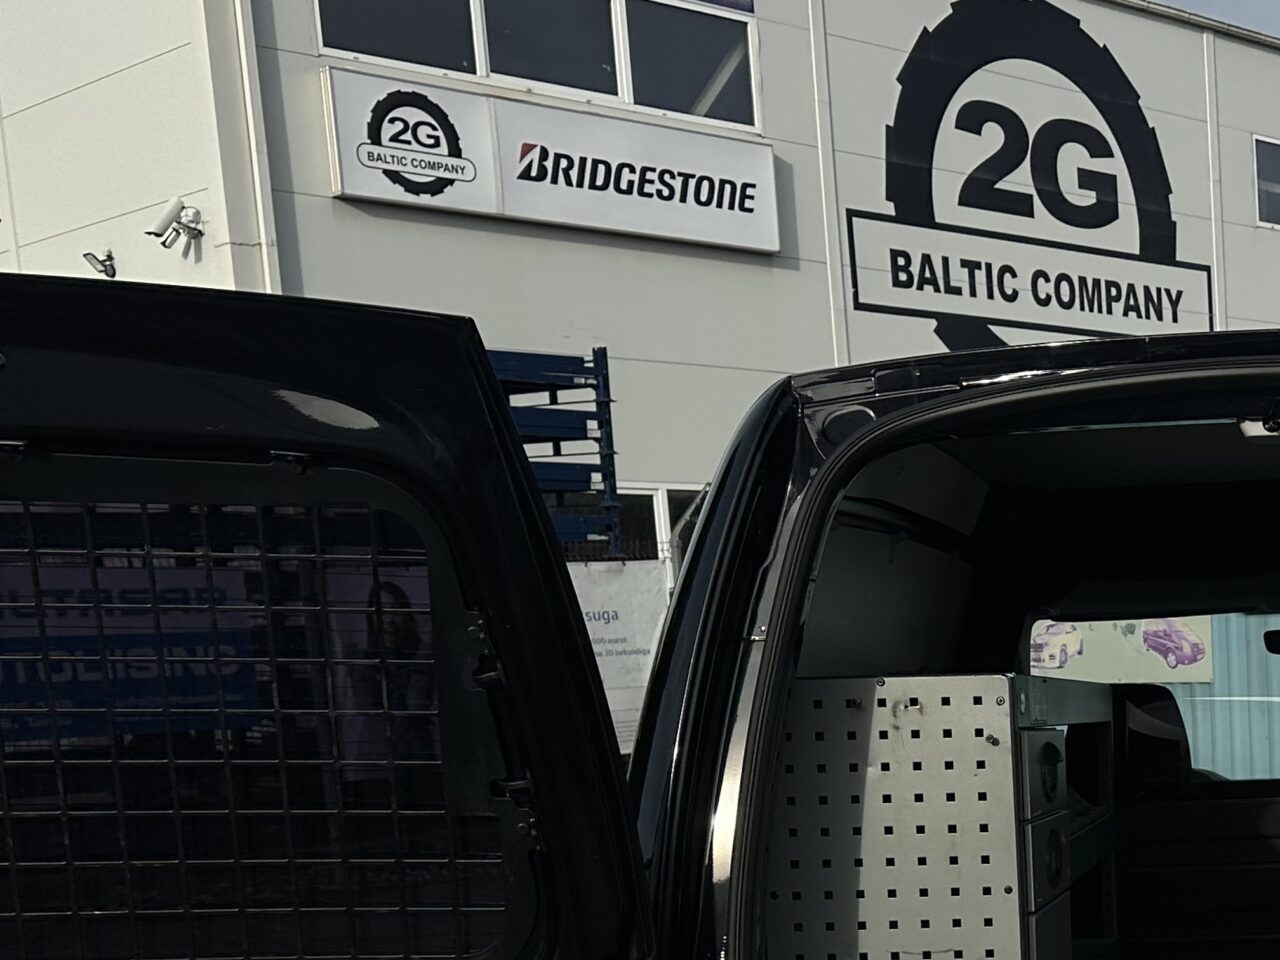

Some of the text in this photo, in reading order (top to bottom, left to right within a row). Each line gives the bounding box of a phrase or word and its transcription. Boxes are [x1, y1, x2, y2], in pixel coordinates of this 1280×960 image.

[367, 150, 466, 175] BALTIC COMPANY
[386, 116, 441, 149] 2G
[955, 99, 1120, 230] 2G
[516, 143, 757, 214] BRIDGESTONE
[889, 247, 1184, 324] BALTIC COMPANY
